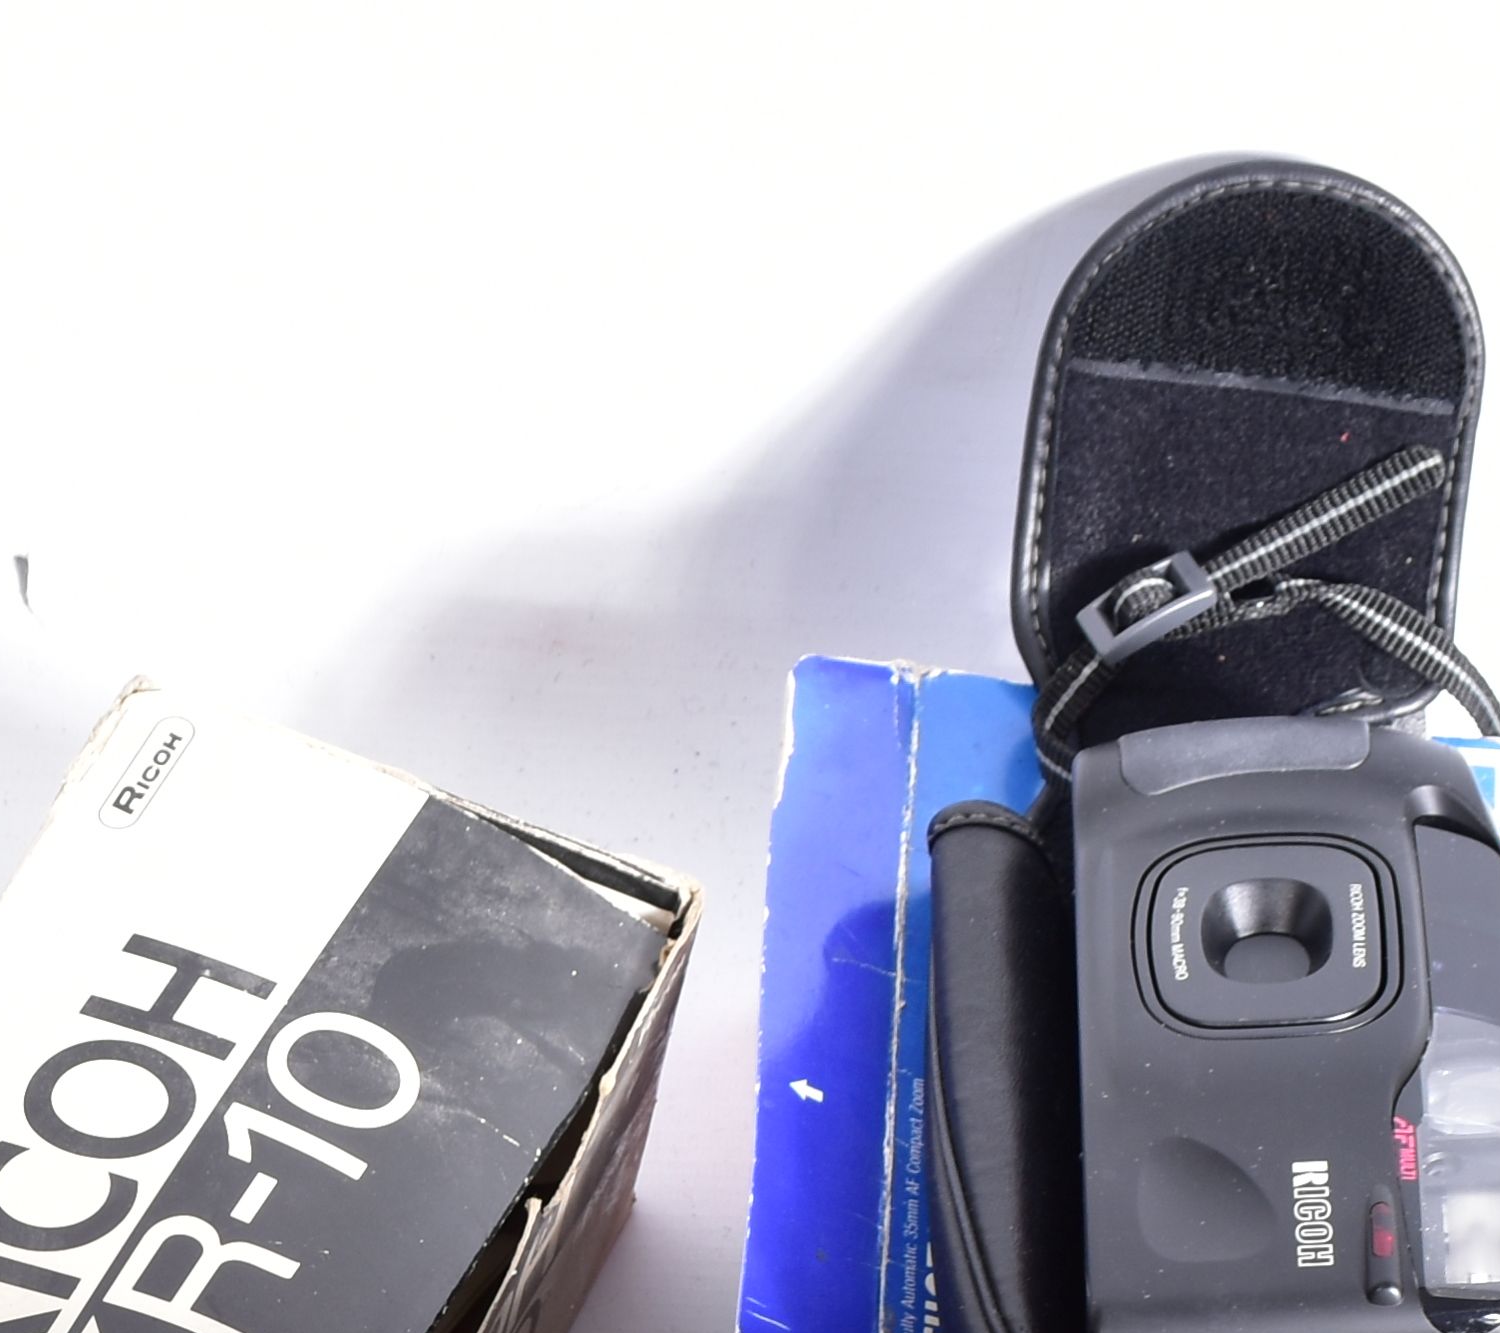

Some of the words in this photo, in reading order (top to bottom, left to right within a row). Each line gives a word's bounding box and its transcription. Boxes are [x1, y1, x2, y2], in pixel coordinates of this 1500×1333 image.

[1349, 883, 1364, 911] RICOH
[1351, 912, 1366, 943] ZOOM
[1172, 943, 1190, 981] MACRO
[1352, 943, 1367, 968] LENS
[908, 1077, 925, 1109] Zoom
[906, 1114, 925, 1174] Compact
[905, 1177, 920, 1196] AF
[904, 1199, 920, 1239] 35mm
[1291, 1160, 1335, 1268] RICOH
[900, 1242, 918, 1307] Automatic
